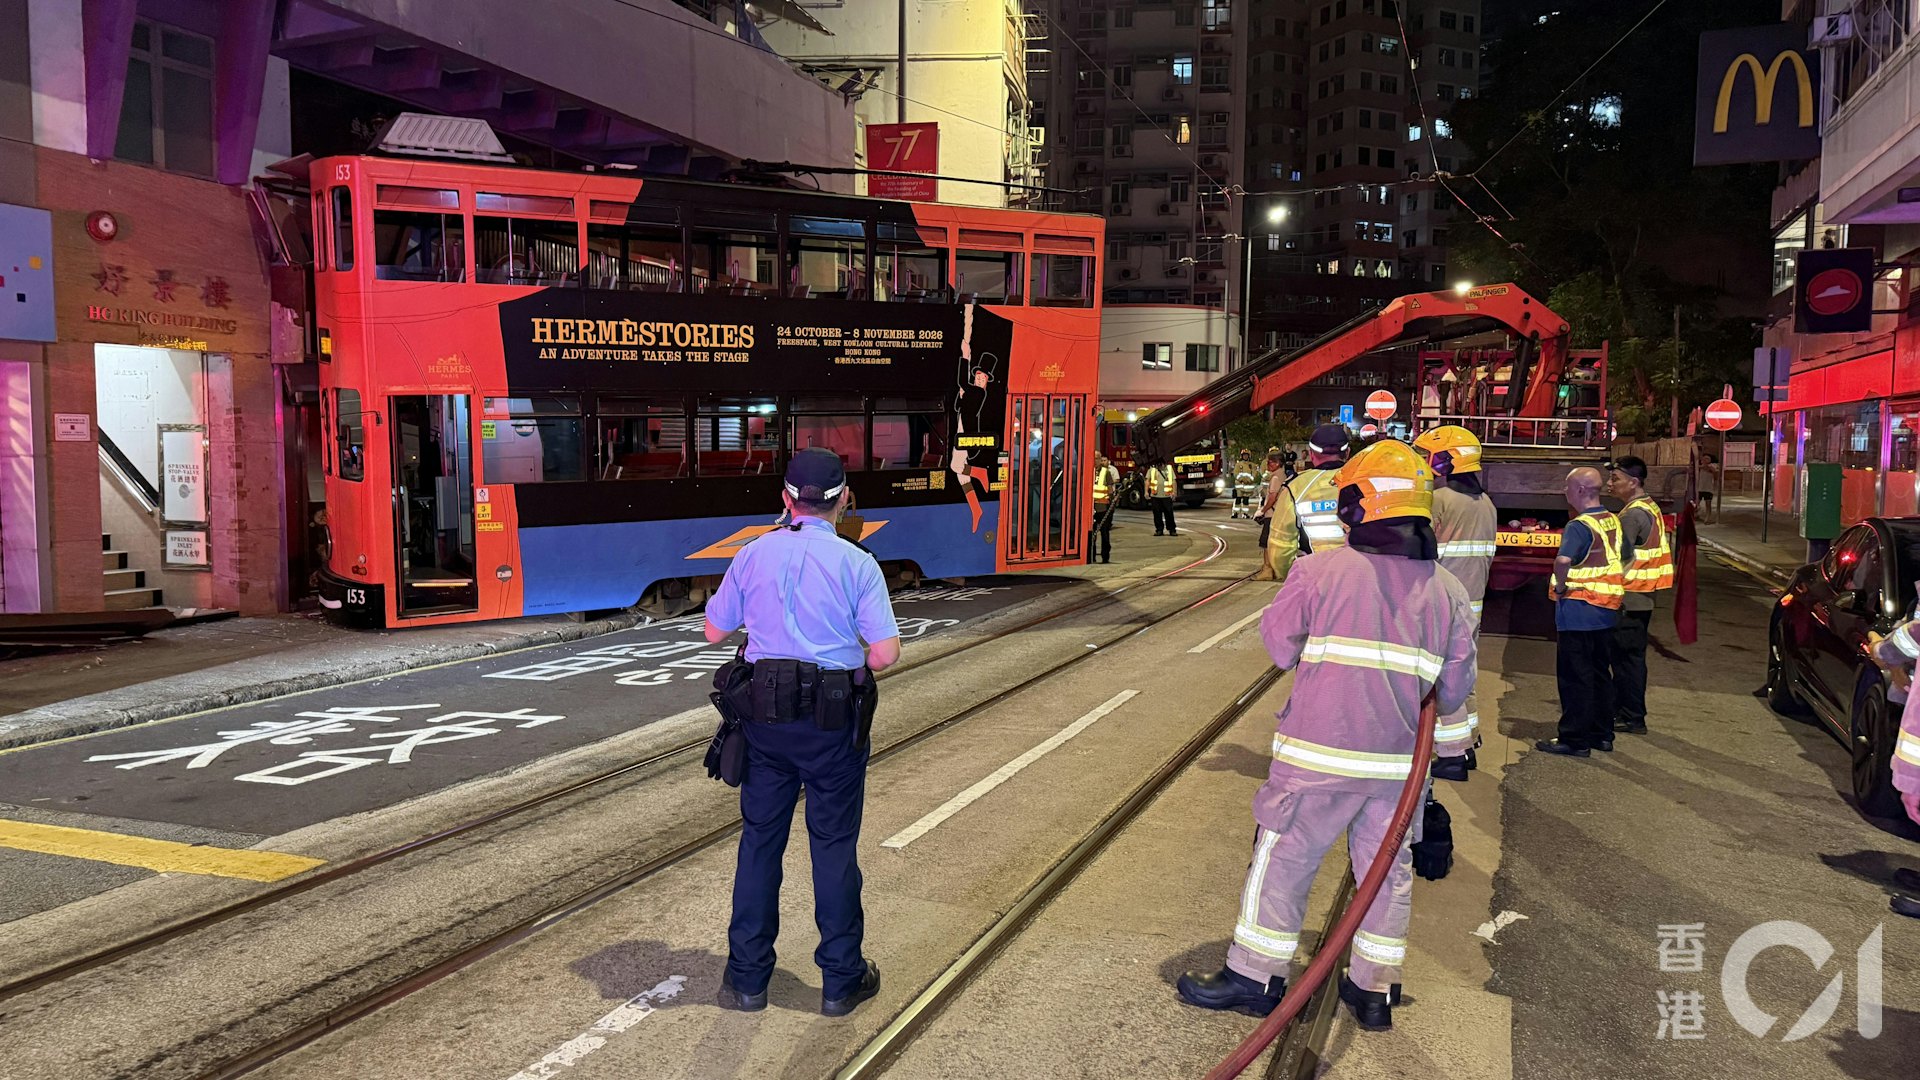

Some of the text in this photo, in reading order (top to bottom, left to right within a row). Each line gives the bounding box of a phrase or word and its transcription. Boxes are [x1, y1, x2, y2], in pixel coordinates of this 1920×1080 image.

[884, 129, 923, 168] 77
[335, 163, 351, 180] 153
[90, 264, 233, 310] 好景樓
[1469, 287, 1507, 297] PALFINGER
[87, 305, 238, 333] HO KING BUILDING
[531, 317, 755, 348] HERMÈSTORIES
[777, 326, 792, 337] 24
[795, 327, 842, 338] OCTOBER
[853, 328, 860, 338] 8
[864, 329, 915, 339] NOVEMBER
[919, 330, 943, 340] 2026
[777, 338, 943, 349] FREESPACE, WEST KOWLOON CULTURAL DISTRICT
[539, 348, 749, 363] AN ADVENTURE TAKES THE STAGE
[845, 348, 862, 356] HONG
[1501, 533, 1557, 546] VG 4531
[347, 588, 366, 605] 153
